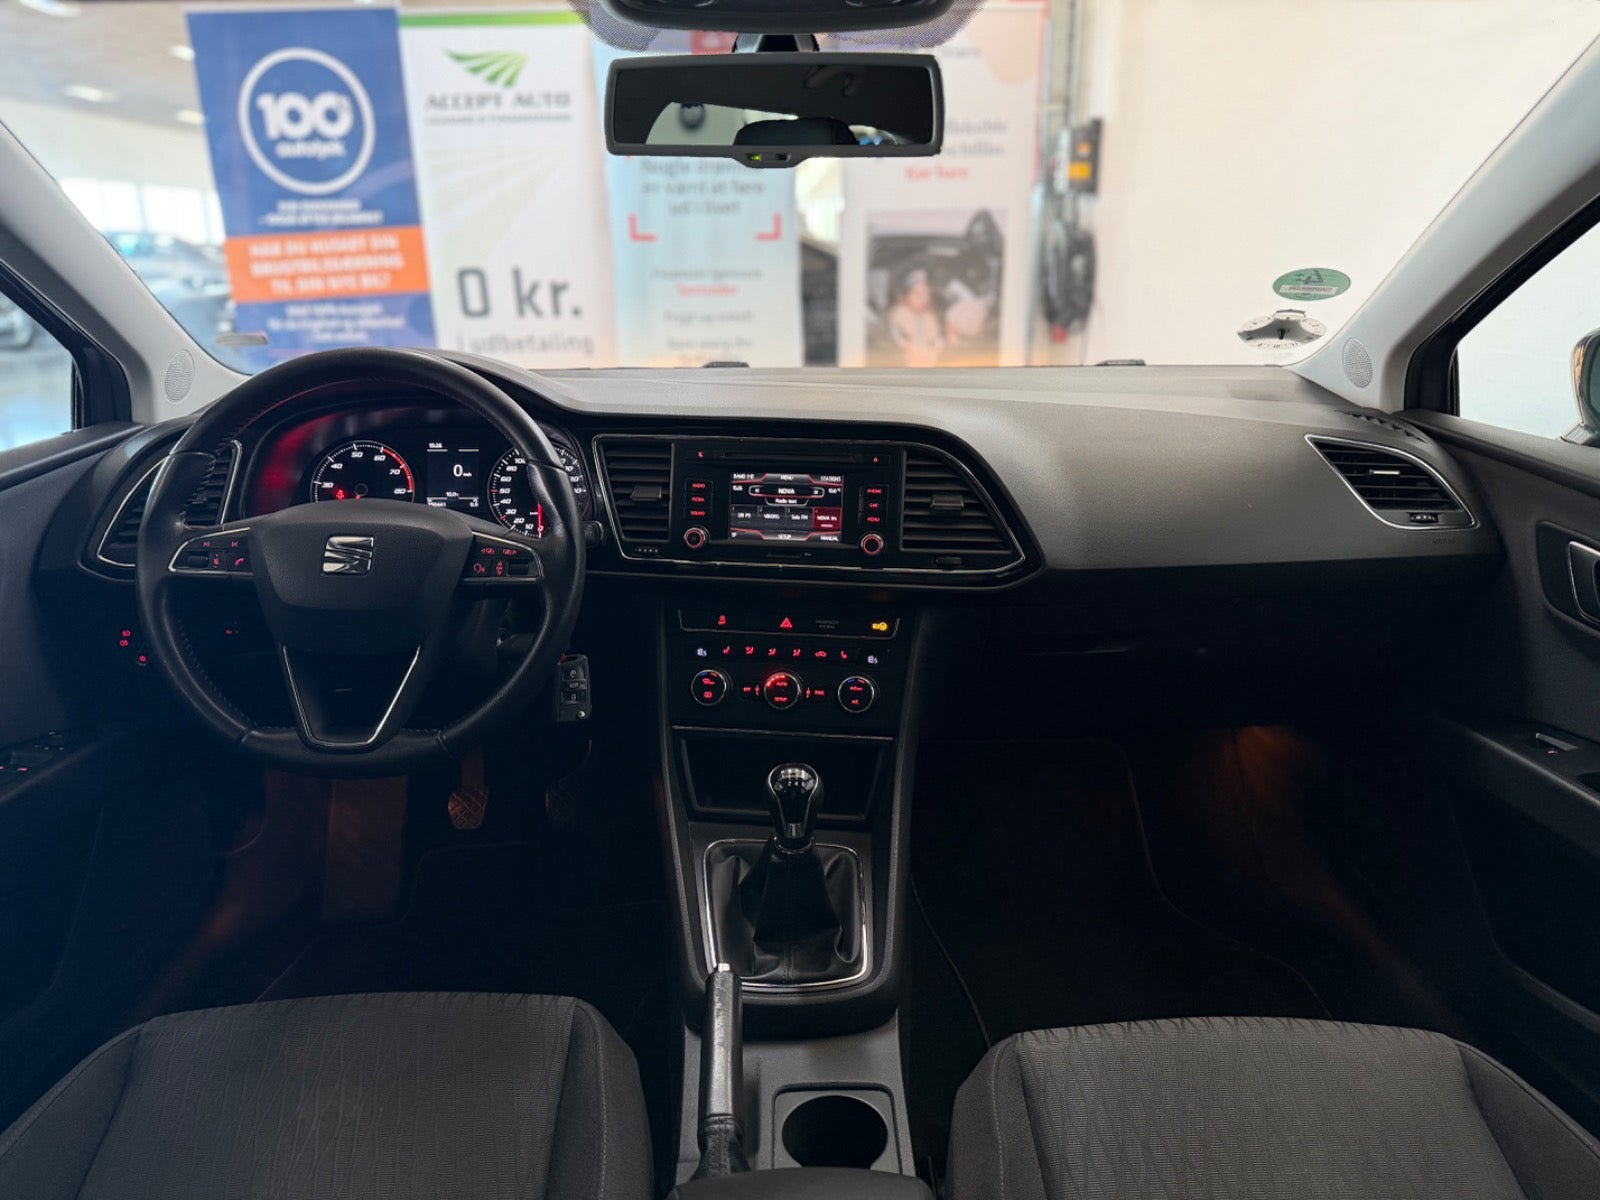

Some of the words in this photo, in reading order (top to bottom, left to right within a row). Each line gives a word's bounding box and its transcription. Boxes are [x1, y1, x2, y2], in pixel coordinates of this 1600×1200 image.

[255, 91, 353, 140] 100
[457, 267, 491, 319] 0
[512, 265, 582, 319] kr.
[453, 464, 463, 477] 0
